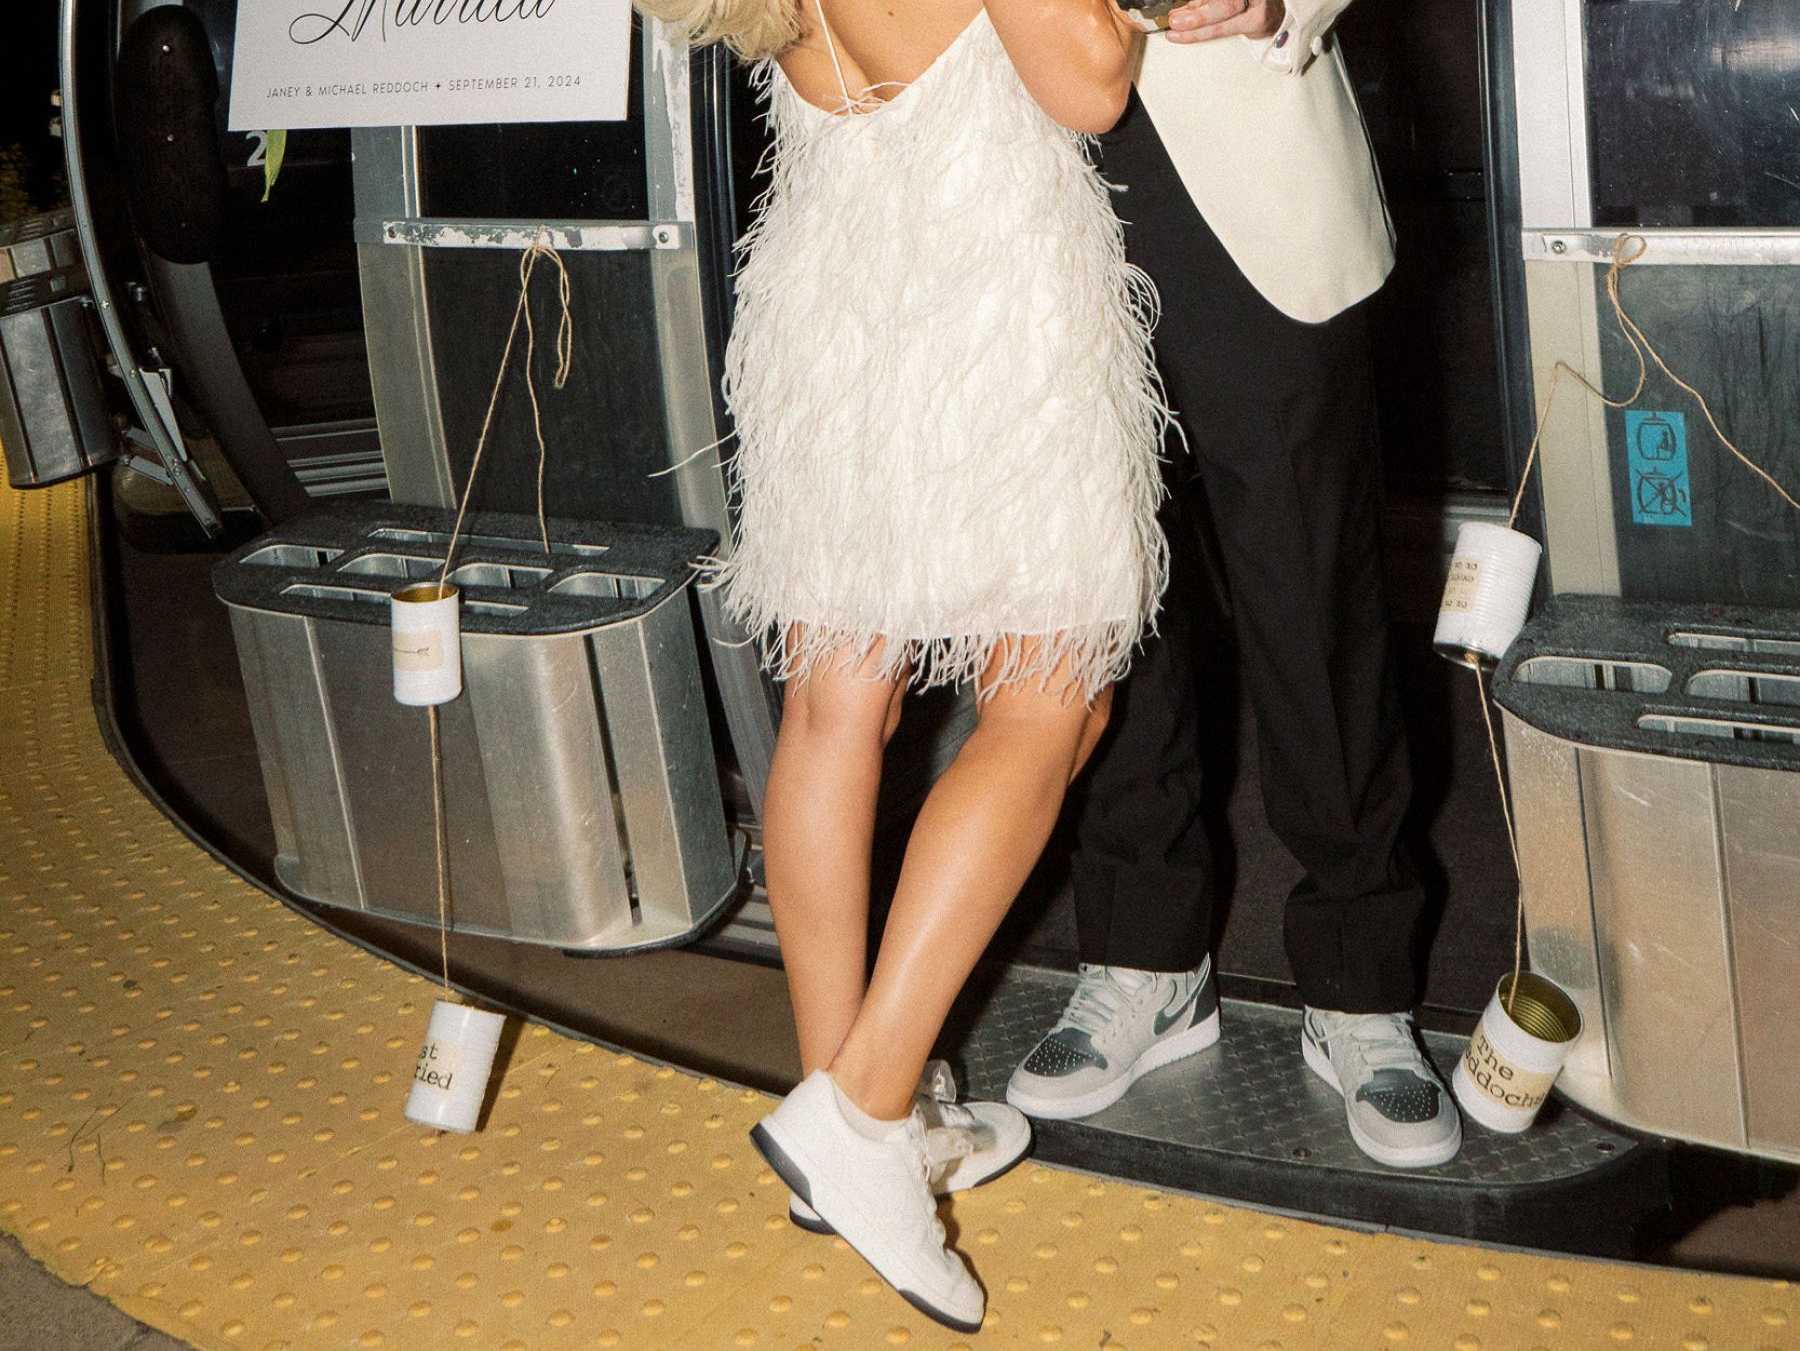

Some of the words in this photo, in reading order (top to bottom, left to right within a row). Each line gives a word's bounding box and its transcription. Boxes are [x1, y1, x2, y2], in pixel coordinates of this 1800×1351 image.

[266, 86, 301, 98] JANEY
[305, 85, 313, 97] &
[318, 83, 367, 96] MICHAEL
[372, 81, 429, 94] REDDOCH
[449, 77, 518, 91] SEPTEMBER
[548, 75, 581, 88] 2024
[245, 130, 267, 167] 2
[419, 1042, 439, 1061] st
[1477, 1035, 1514, 1081] The
[413, 1063, 453, 1090] ried
[1465, 1048, 1545, 1108] eddochs
